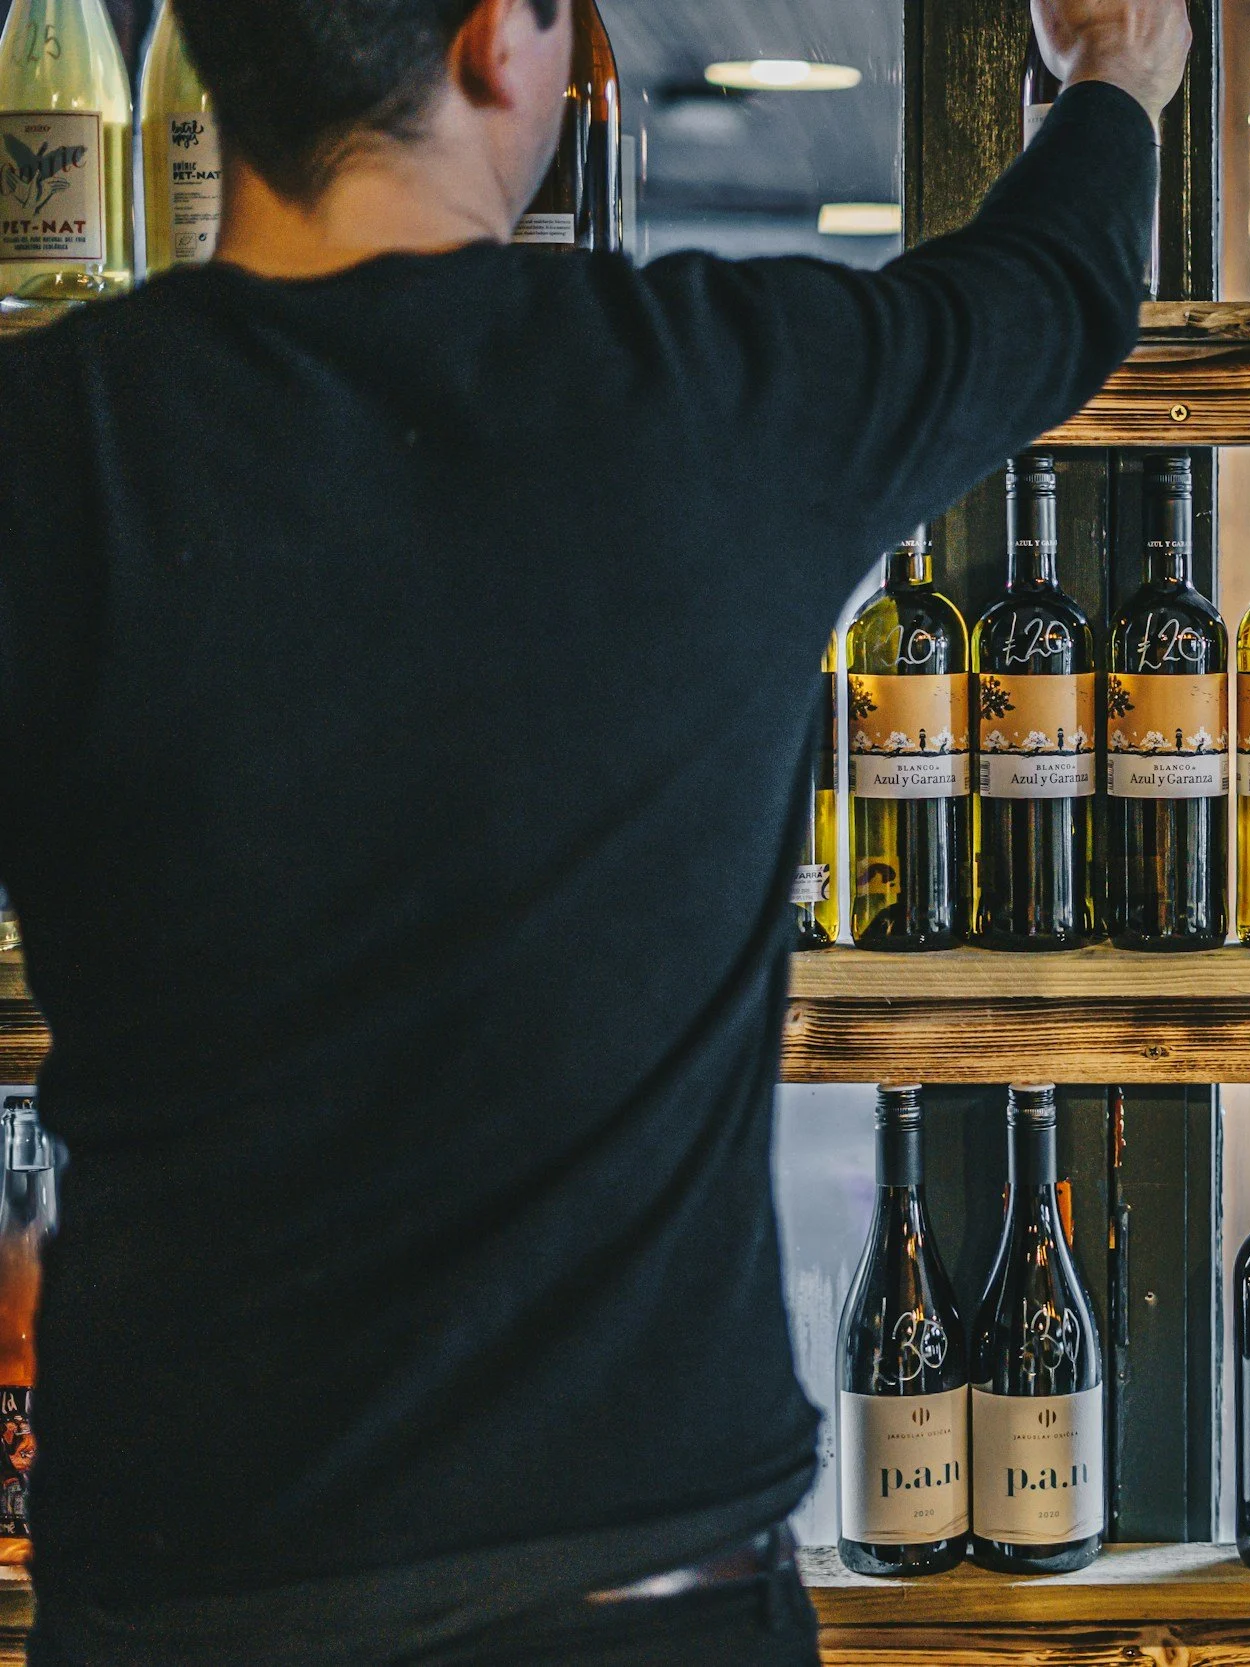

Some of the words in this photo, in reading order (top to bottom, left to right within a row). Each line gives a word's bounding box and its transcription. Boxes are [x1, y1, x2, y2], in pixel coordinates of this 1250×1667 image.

[1034, 539, 1040, 547] Y
[1003, 612, 1071, 666] £20
[1137, 612, 1206, 672] £20
[874, 773, 900, 785] Azul
[901, 775, 909, 787] y
[911, 773, 956, 785] Garanza
[1010, 773, 1038, 785] Azul
[1040, 775, 1048, 787] y
[1049, 772, 1089, 784] Garanza
[1130, 773, 1155, 784] Azul
[1158, 775, 1165, 787] y
[1167, 773, 1213, 784] Garanza
[887, 1432, 924, 1440] JAROSLAV
[880, 1460, 960, 1498] p.a.n
[1003, 1462, 1088, 1497] p.a.n
[914, 1509, 935, 1518] 2020
[1038, 1510, 1060, 1518] 2020
